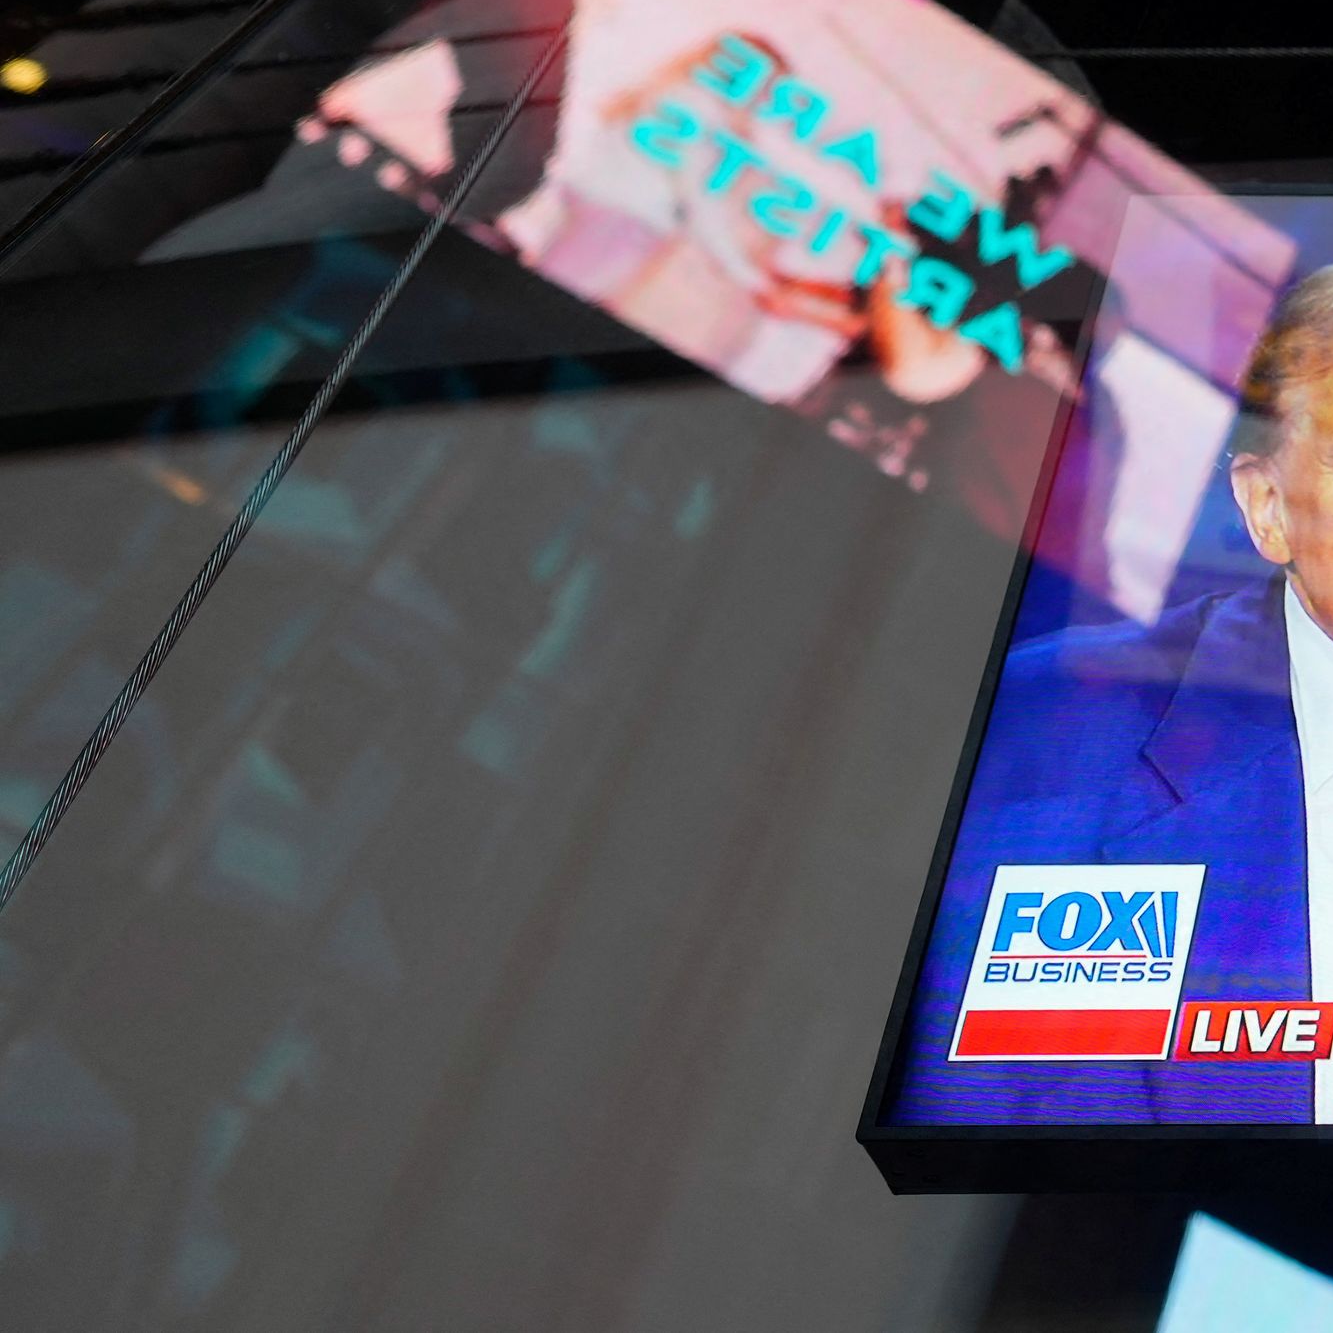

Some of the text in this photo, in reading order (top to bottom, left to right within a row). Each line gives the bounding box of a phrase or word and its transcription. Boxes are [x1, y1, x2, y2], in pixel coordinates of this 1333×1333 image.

[991, 890, 1156, 952] FOX
[983, 961, 1174, 984] BUSINESS
[1190, 1008, 1319, 1053] LIVE
